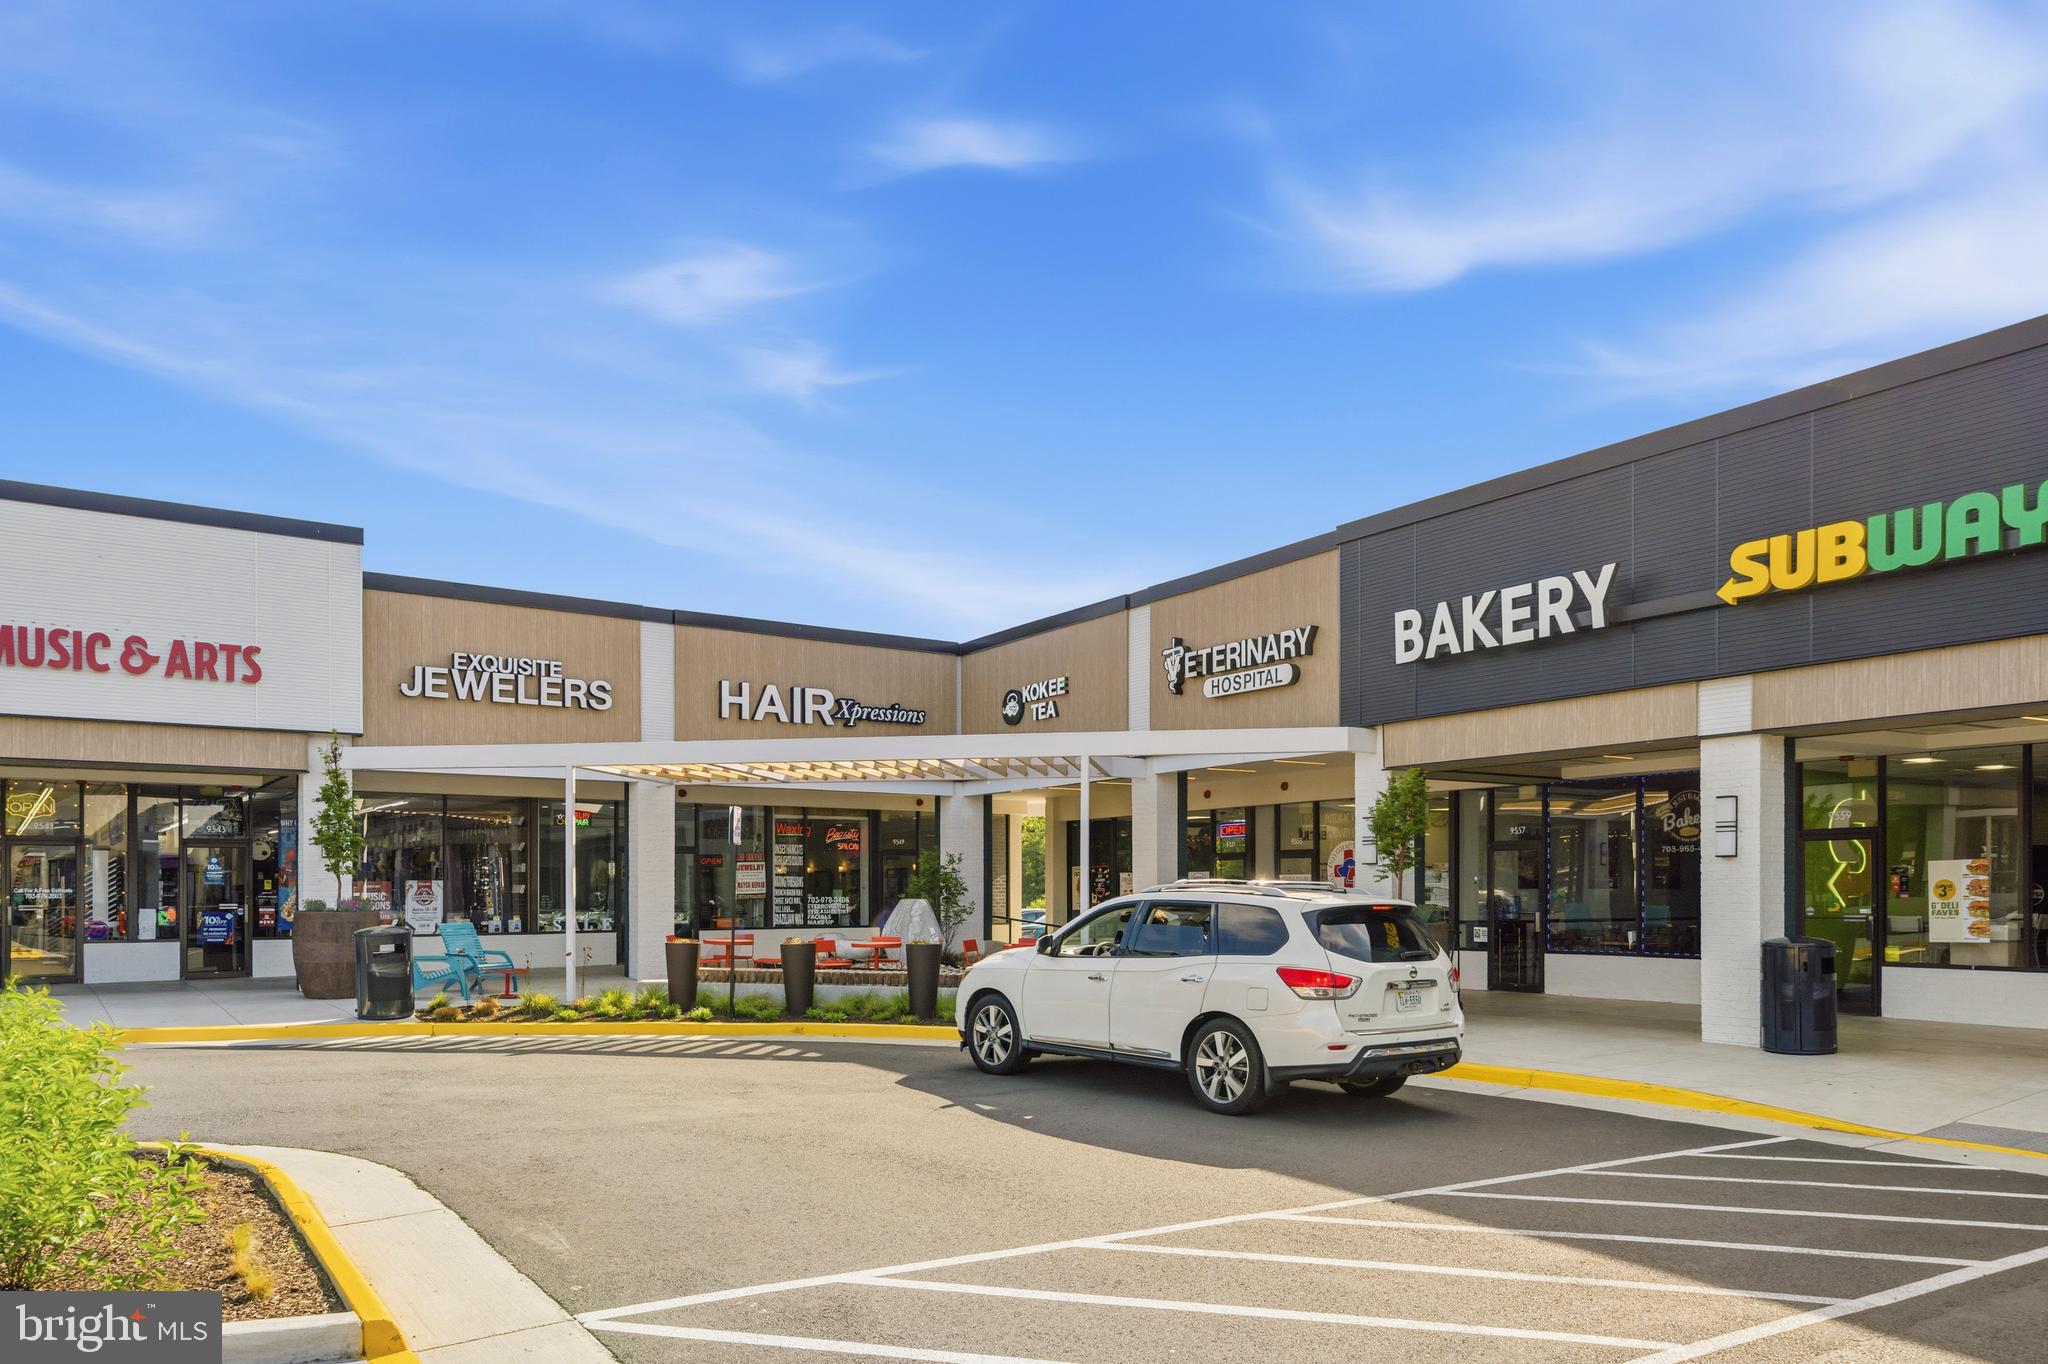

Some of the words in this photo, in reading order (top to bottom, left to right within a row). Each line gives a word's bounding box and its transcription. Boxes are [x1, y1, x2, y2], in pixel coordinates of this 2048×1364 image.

[1394, 562, 1618, 665] BAKERY
[0, 624, 111, 673] MUSIC
[120, 635, 161, 675] &
[164, 639, 262, 685] ARTS
[453, 652, 562, 678] EXQUISITE
[400, 665, 613, 711] JEWELERS
[1022, 676, 1069, 703] KOKEE
[1210, 667, 1284, 695] HOSPITAL
[719, 679, 834, 726] HAIR
[835, 698, 925, 727] Xpressions
[1030, 700, 1058, 721] TEA
[206, 825, 226, 834] 9543
[1223, 826, 1245, 836] OPEN
[1510, 826, 1526, 835] 9557
[1660, 807, 1700, 832] Bake
[837, 842, 859, 850] SALON
